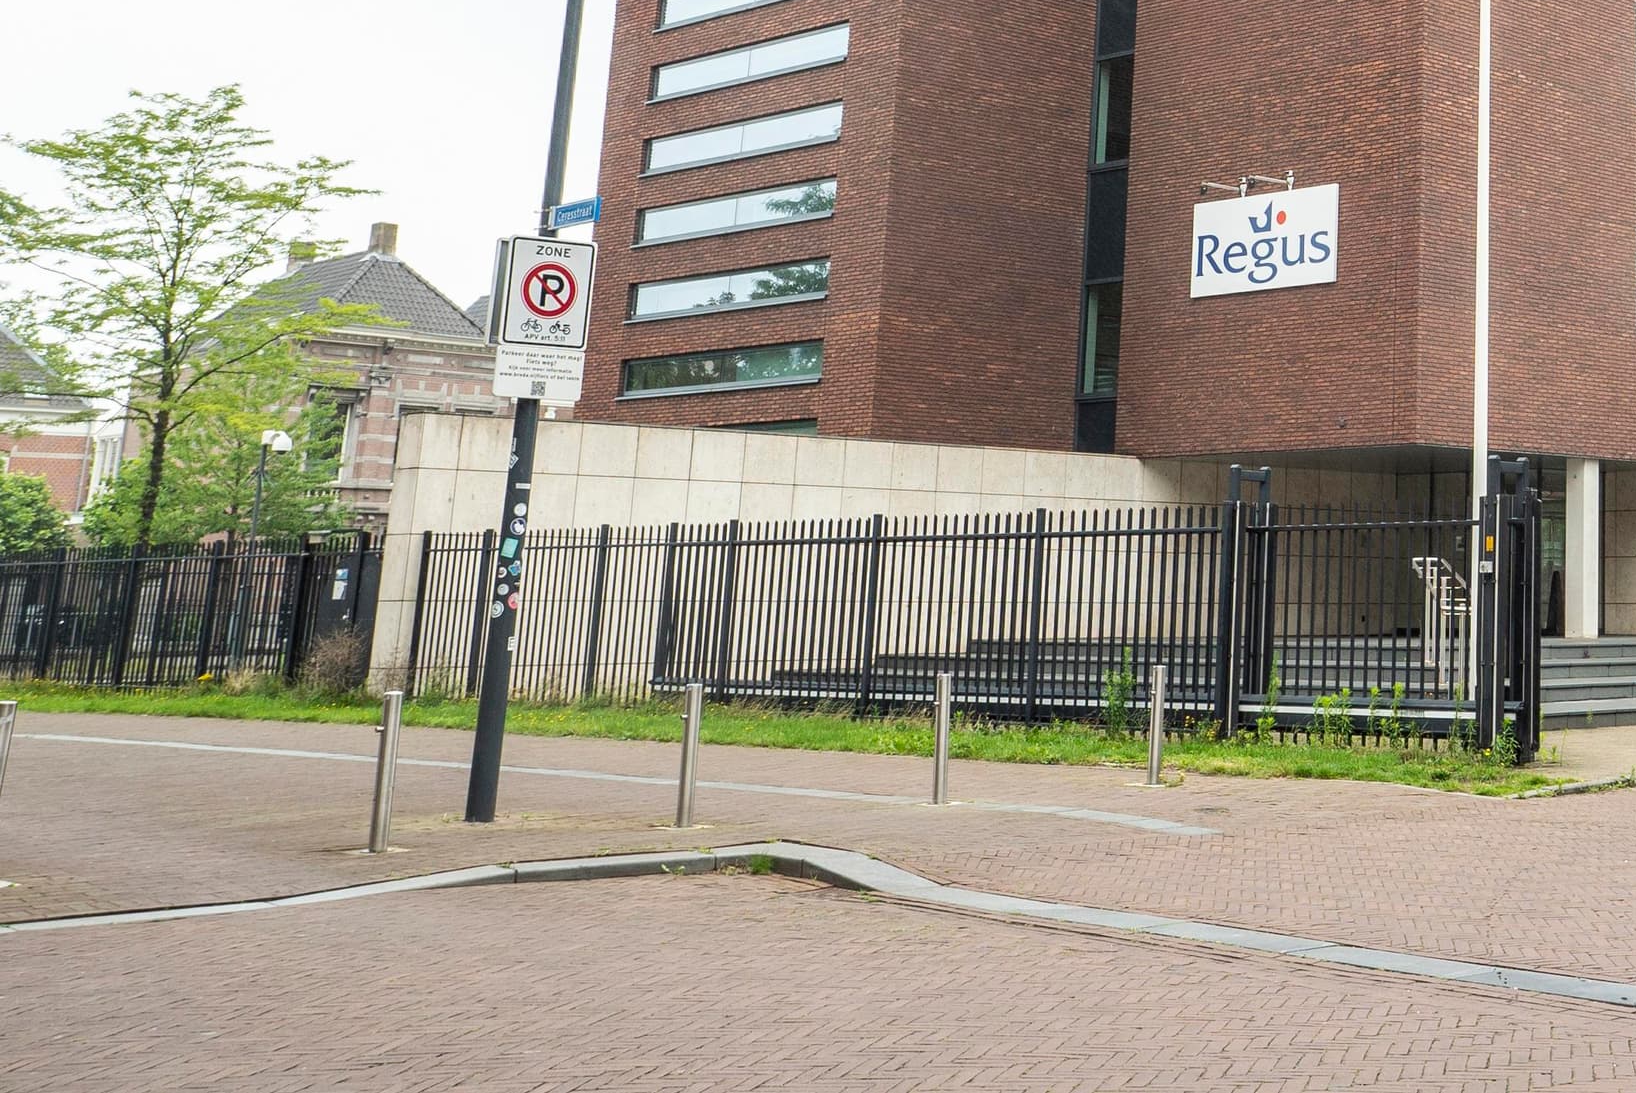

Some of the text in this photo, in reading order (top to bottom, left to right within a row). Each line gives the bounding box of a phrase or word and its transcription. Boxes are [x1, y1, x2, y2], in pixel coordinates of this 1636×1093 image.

[558, 205, 592, 221] Ceresstraat
[536, 245, 571, 258] ZONE
[1196, 231, 1331, 284] Regus
[540, 274, 565, 307] P
